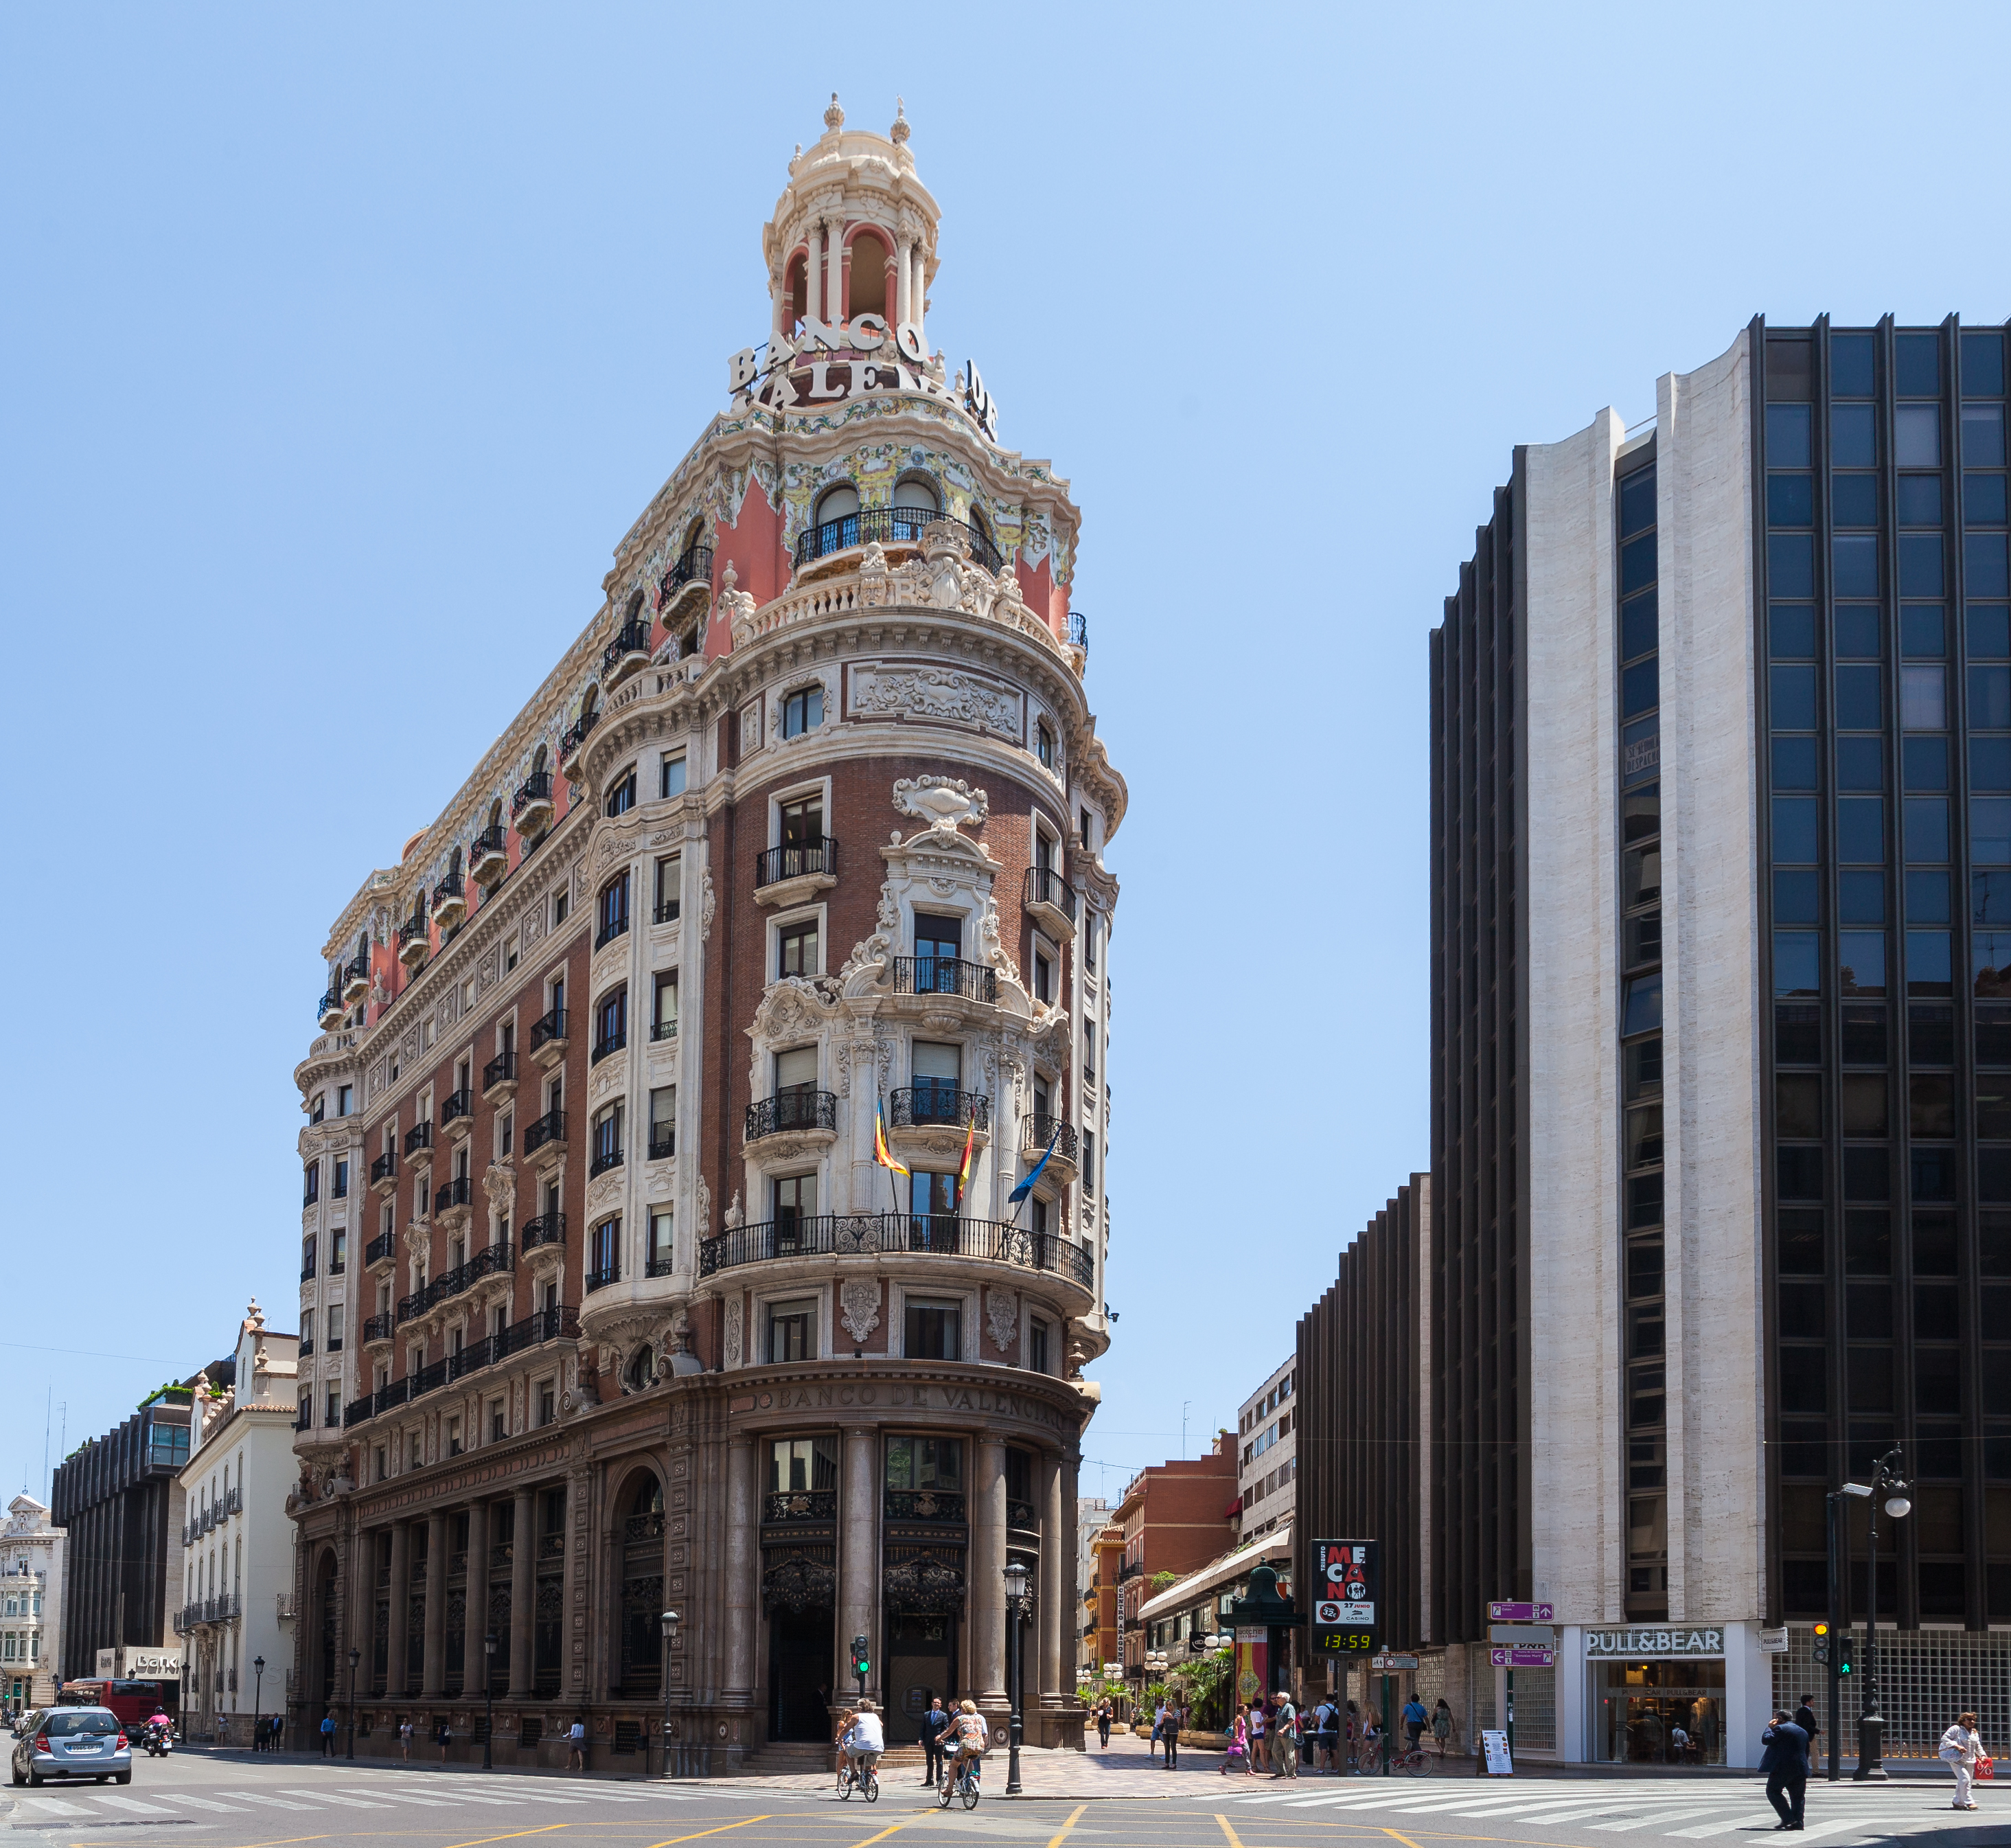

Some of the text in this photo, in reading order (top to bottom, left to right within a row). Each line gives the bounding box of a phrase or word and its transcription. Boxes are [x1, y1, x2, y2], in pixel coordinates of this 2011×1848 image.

[728, 313, 998, 443] BANCO DE
[777, 1385, 1050, 1424] BANCO DE VALENCIA
[1325, 1634, 1370, 1648] 13:59
[1586, 1631, 1721, 1652] PULL&BEAR
